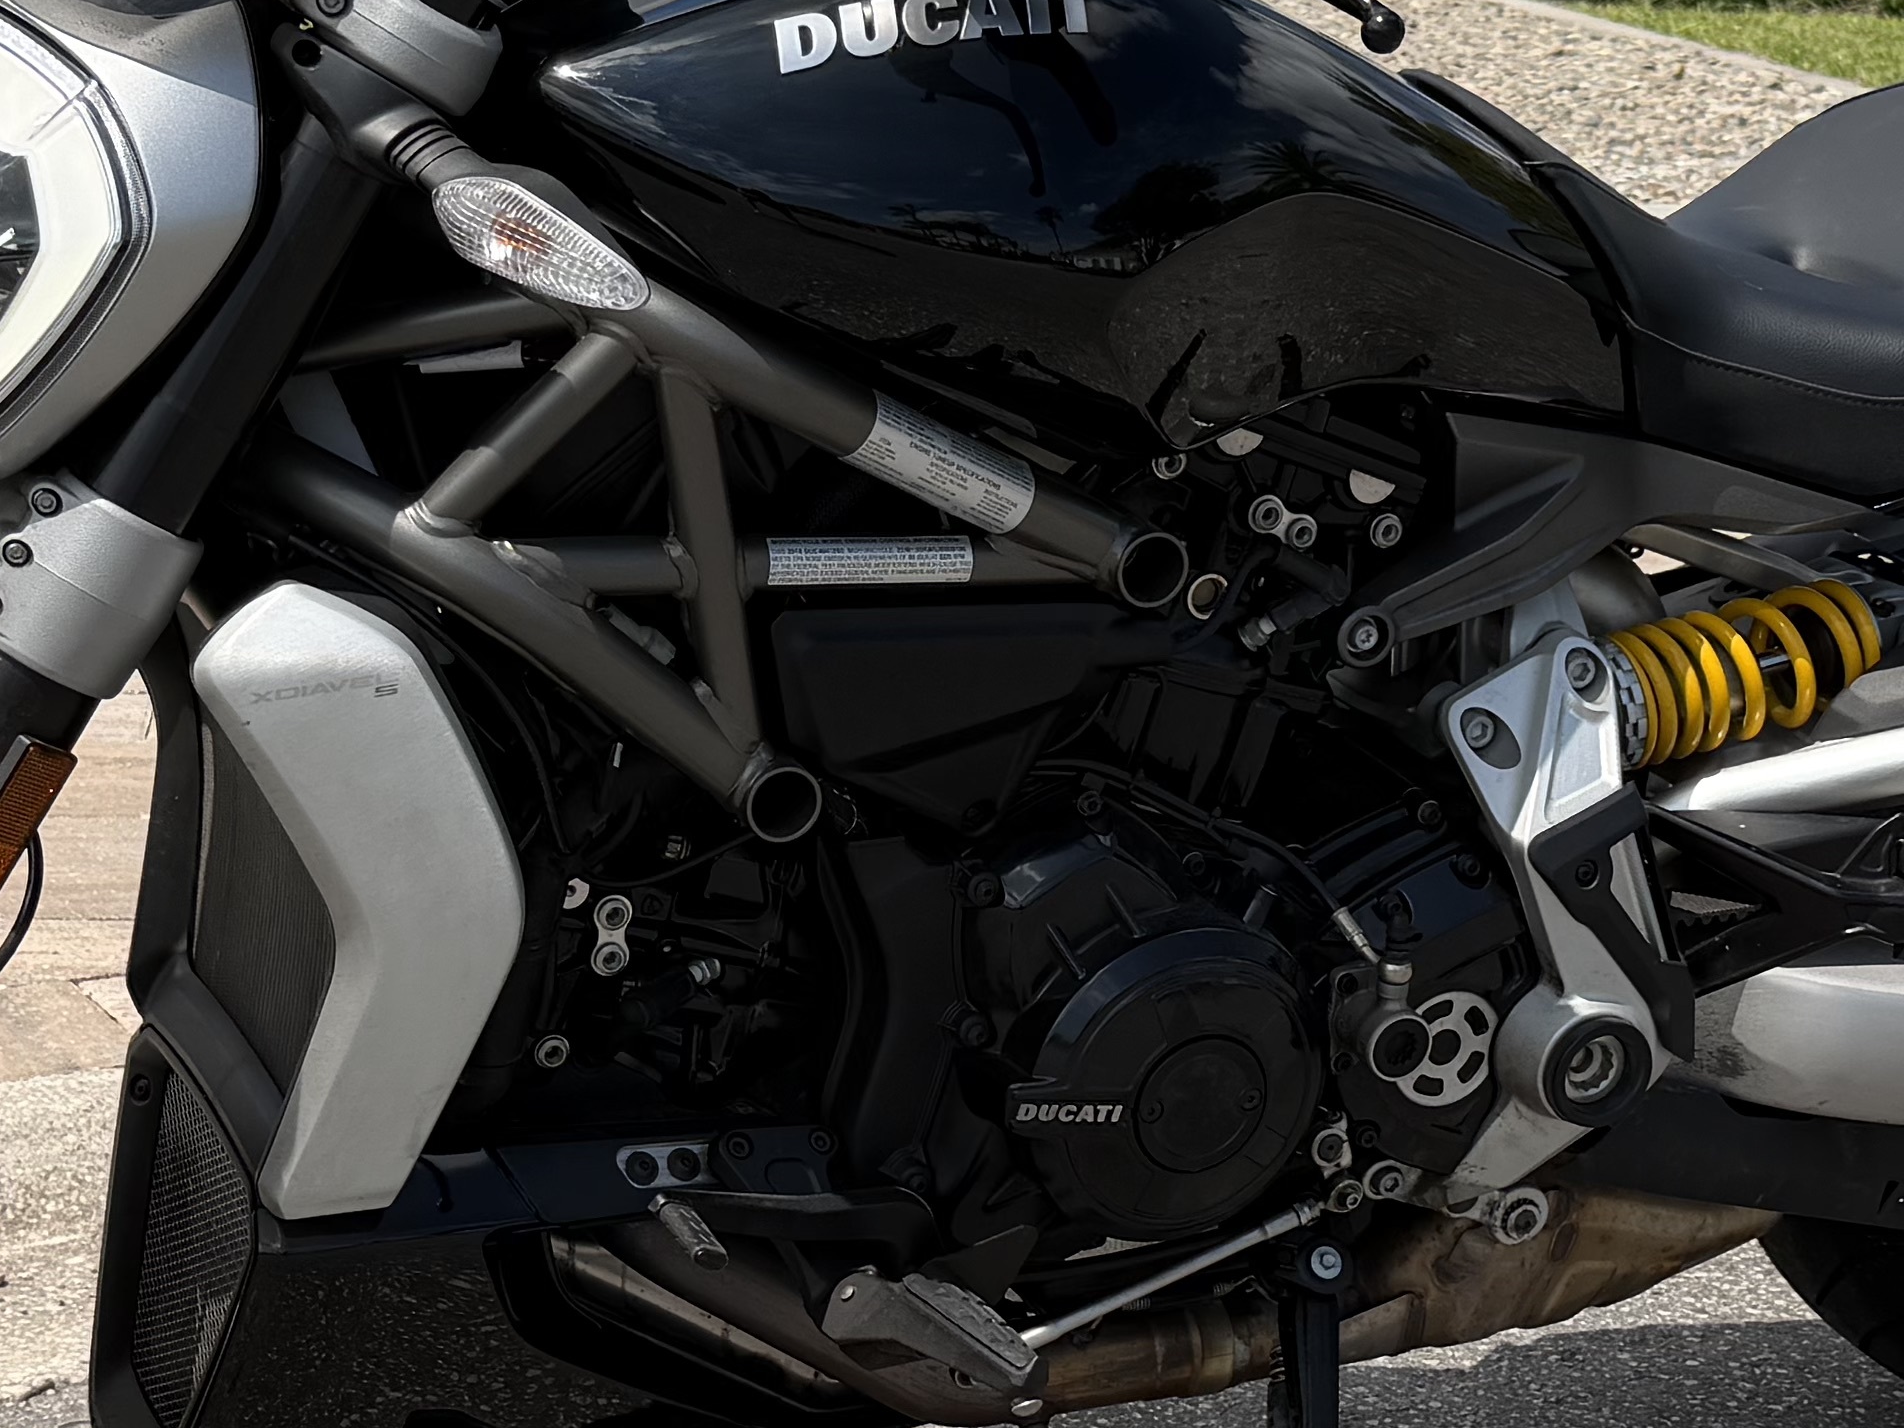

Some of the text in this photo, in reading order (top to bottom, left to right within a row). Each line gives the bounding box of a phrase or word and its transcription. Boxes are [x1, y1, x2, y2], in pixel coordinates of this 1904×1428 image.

[250, 673, 399, 705] XDIAVEL
[373, 683, 399, 698] S
[1015, 1102, 1124, 1123] DUCATI
